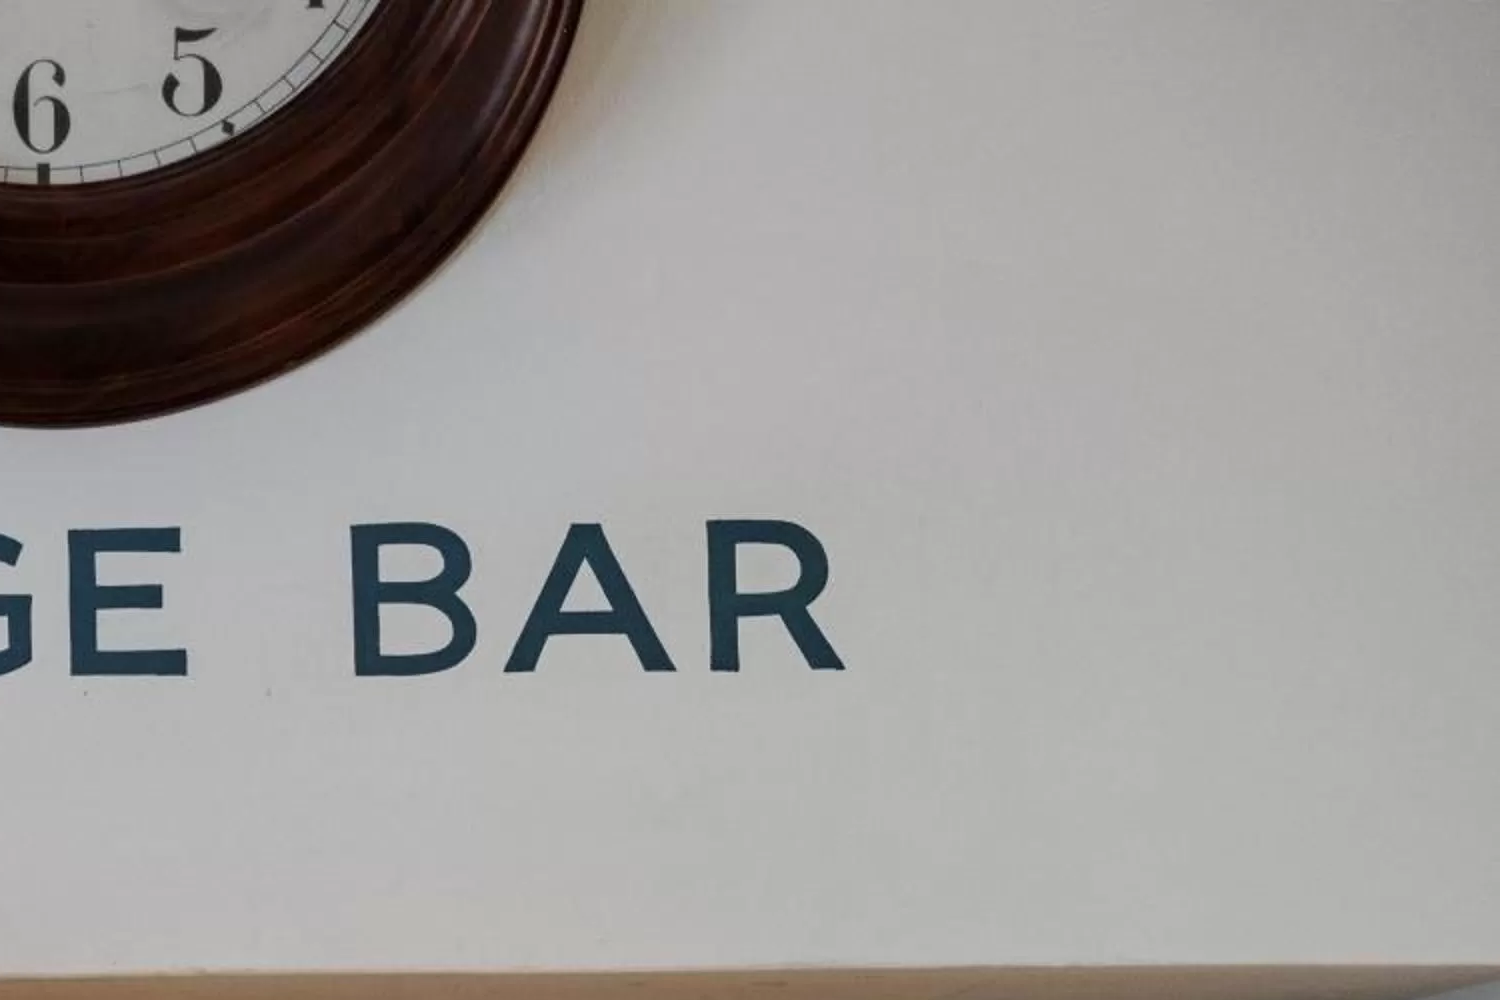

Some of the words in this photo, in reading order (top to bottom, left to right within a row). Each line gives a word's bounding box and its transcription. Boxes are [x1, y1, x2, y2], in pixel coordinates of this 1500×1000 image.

[12, 58, 72, 154] 6
[160, 26, 224, 118] 5
[348, 518, 847, 678] BAR
